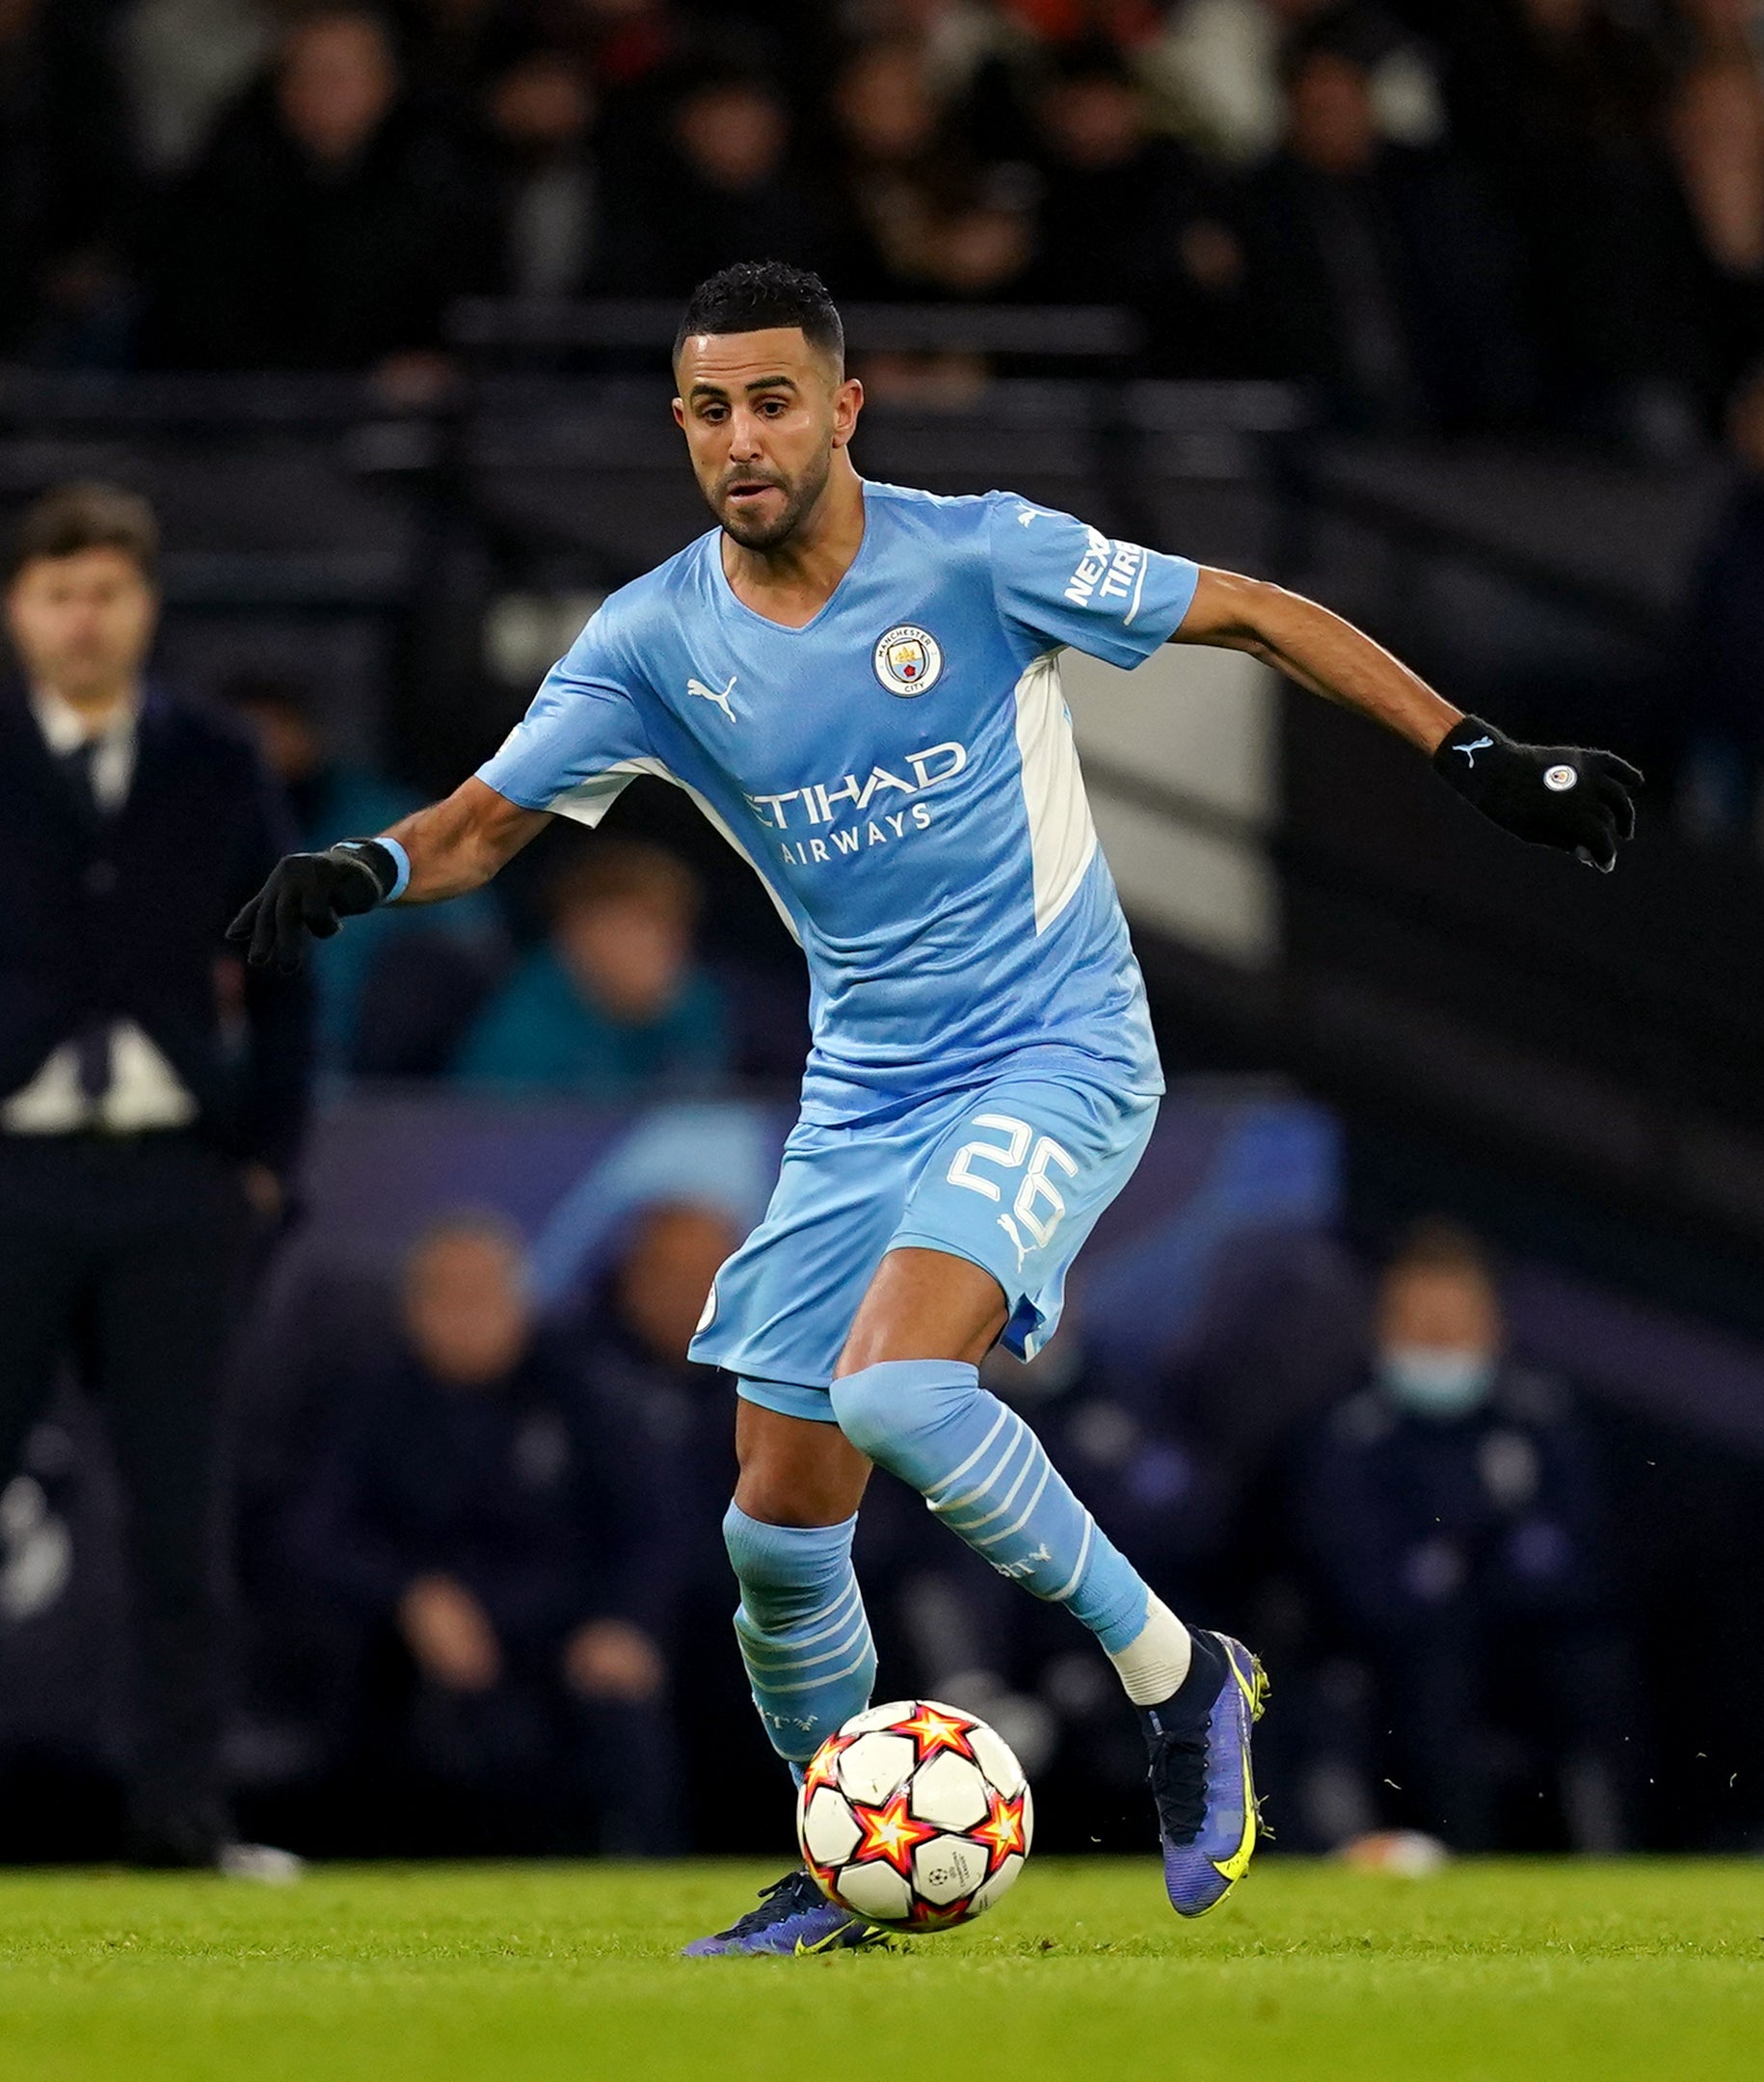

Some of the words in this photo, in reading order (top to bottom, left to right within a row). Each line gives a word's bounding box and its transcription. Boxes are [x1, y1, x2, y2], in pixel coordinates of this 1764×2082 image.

[878, 628, 931, 657] MANCHESTER
[904, 681, 924, 693] CITY
[781, 802, 932, 866] AIRWAYS
[947, 1113, 1079, 1248] 26
